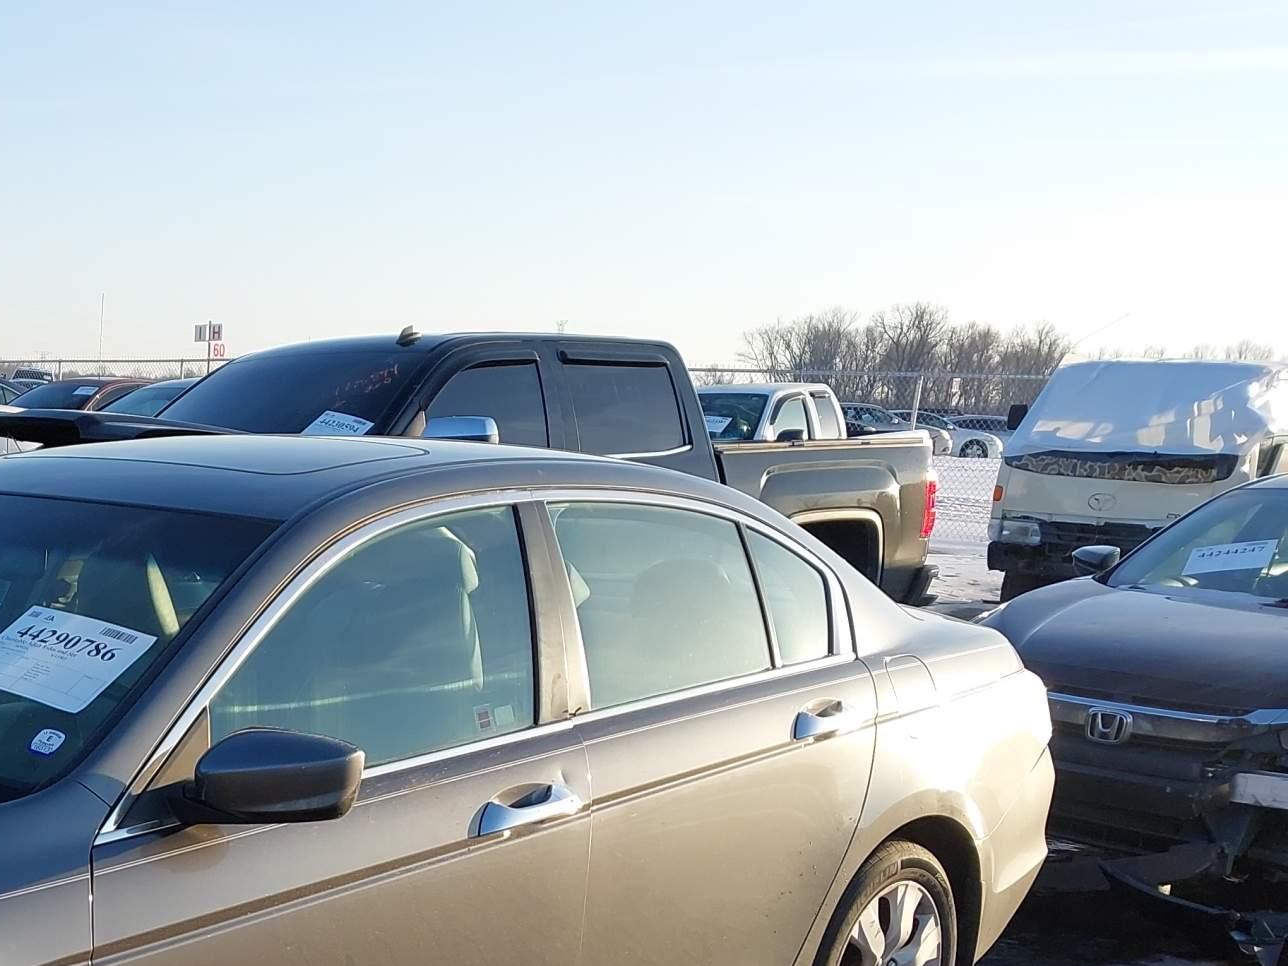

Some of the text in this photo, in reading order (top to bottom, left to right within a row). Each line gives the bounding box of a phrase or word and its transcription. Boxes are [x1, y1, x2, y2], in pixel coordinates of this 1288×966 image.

[212, 325, 221, 340] H
[213, 343, 225, 357] 60
[16, 624, 123, 662] 44290786
